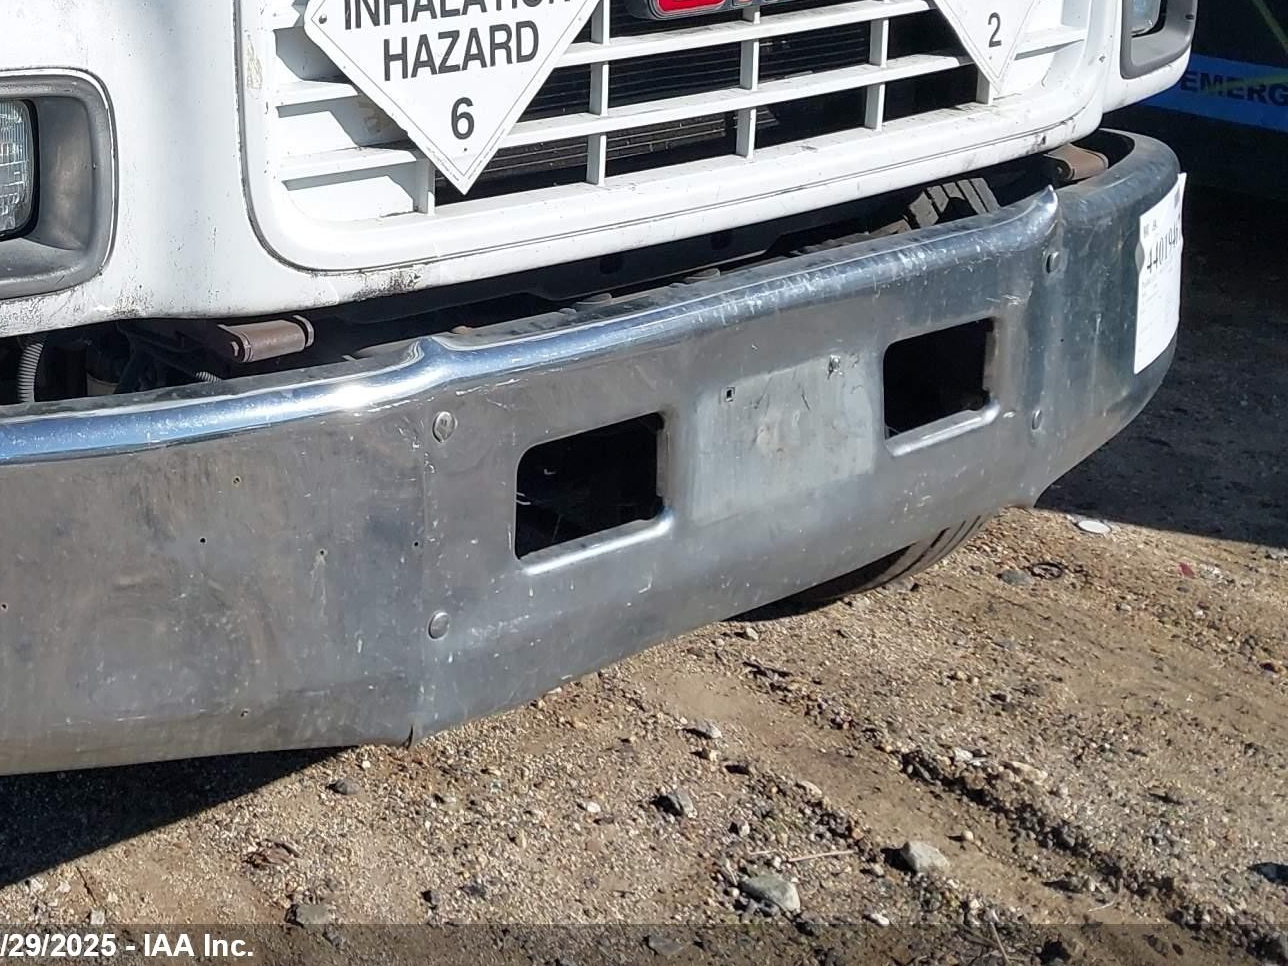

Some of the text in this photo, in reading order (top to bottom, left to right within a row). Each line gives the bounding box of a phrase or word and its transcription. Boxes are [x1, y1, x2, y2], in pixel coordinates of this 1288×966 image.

[383, 20, 540, 82] HAZARD
[987, 13, 1001, 48] 2
[450, 96, 475, 140] 6
